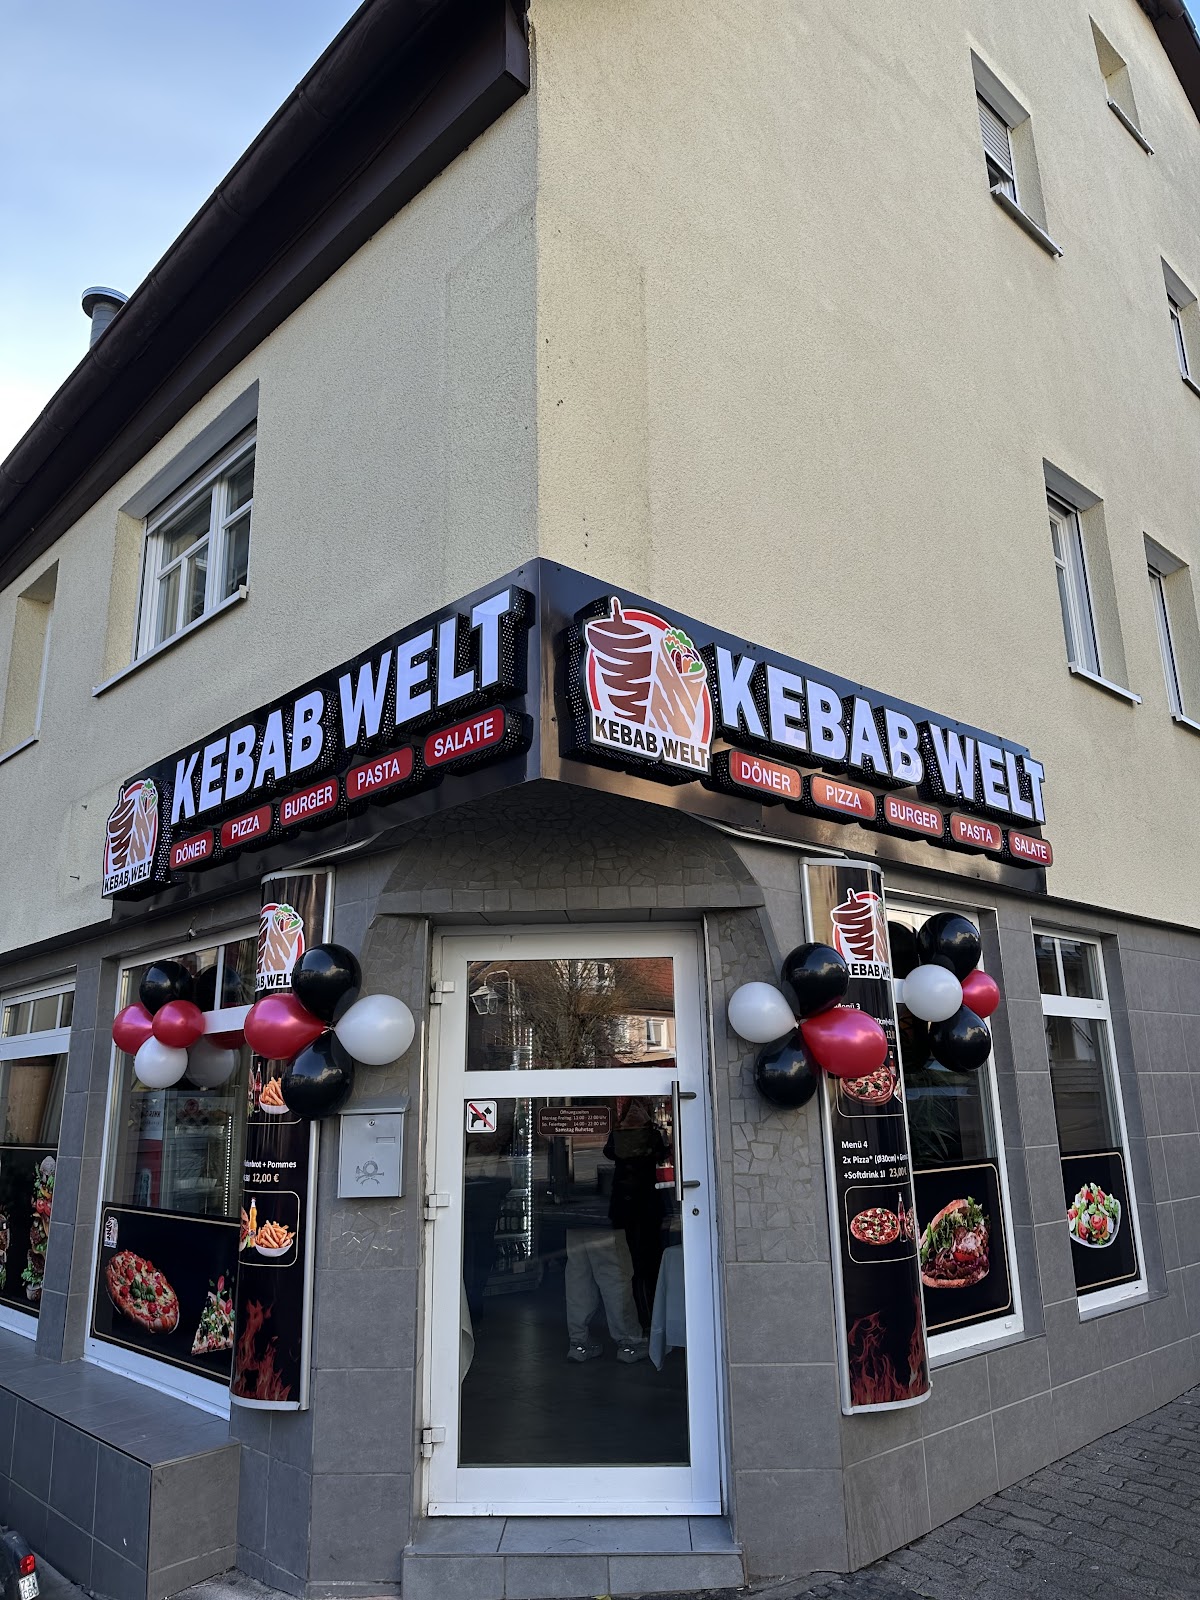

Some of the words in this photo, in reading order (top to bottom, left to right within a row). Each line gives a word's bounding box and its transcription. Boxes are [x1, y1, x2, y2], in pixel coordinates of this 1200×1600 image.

[171, 691, 324, 825] KEBAB
[339, 589, 510, 748] WELT
[716, 645, 923, 785] KEBAB
[929, 723, 1046, 823] WELT
[595, 715, 658, 754] KEBAB
[662, 736, 708, 769] WELT
[175, 840, 207, 864] DÖNER
[231, 815, 260, 840] PIZZA
[284, 785, 334, 820] BURGER
[357, 758, 401, 791] PASTA
[433, 717, 495, 758] SALATE
[740, 759, 793, 793] DÖNER
[825, 784, 863, 810] PIZZA
[890, 800, 940, 831] BURGER
[959, 821, 995, 845] PASTA
[1013, 835, 1048, 862] SALATE
[104, 870, 129, 893] KEBAB
[131, 860, 151, 882] WELT
[267, 1160, 297, 1168] Pommes
[841, 1140, 862, 1149] Menü
[863, 1140, 868, 1149] 4
[842, 1155, 851, 1164] 2x
